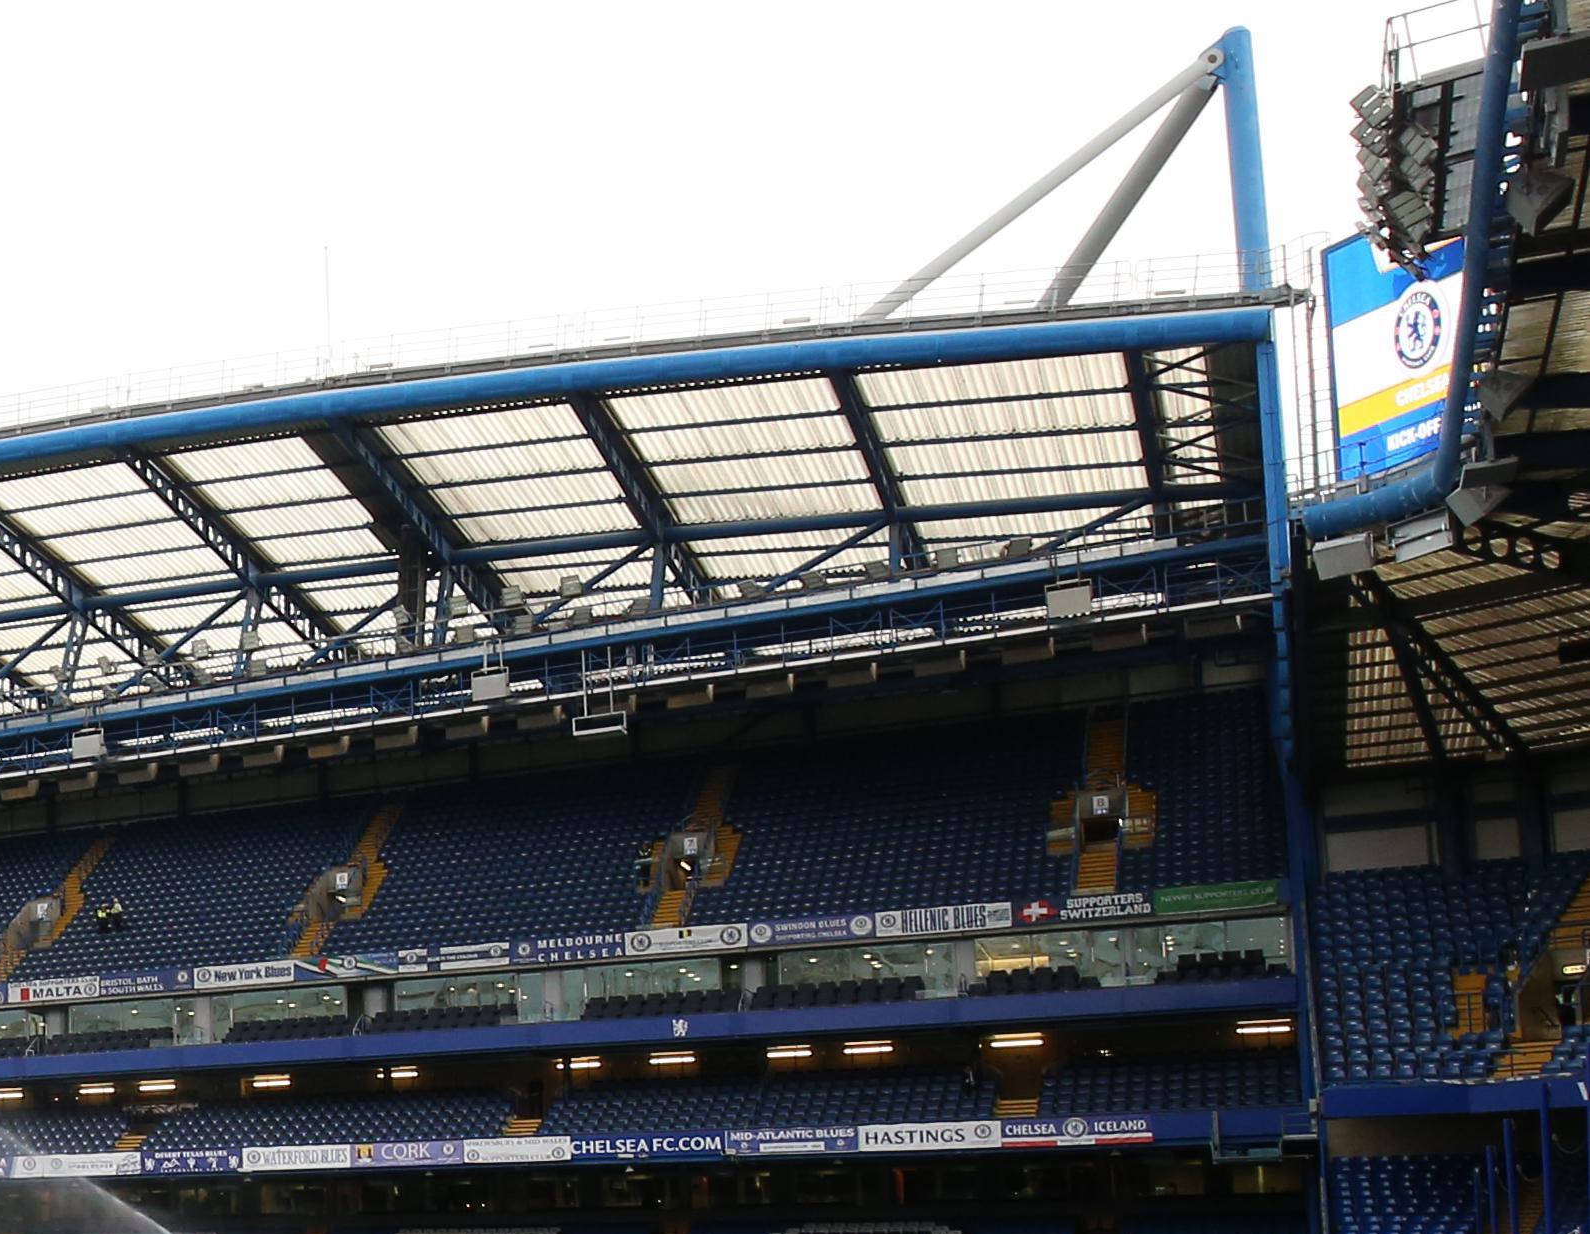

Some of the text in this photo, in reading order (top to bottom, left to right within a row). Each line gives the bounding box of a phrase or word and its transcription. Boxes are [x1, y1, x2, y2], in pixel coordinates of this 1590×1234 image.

[1066, 893, 1144, 909] SUPPORTERS
[1060, 902, 1151, 920] SWITZERLAND
[775, 918, 847, 932] SWINDON BLUES
[901, 910, 949, 934] HELLENIC
[953, 905, 987, 929] BLUES
[537, 933, 622, 949] MELBOURNE
[538, 947, 624, 963] CHELSEA
[136, 975, 158, 985] BATH
[214, 964, 292, 983] New York Blues
[33, 986, 82, 998] MALTA
[730, 1127, 855, 1141] MID-ATLANTIC BLUES
[1005, 1119, 1147, 1136] CHELSEA ICELAND
[865, 1128, 966, 1145] HASTINGS
[260, 1149, 319, 1165] WATERFORD
[381, 1143, 432, 1160] CORK
